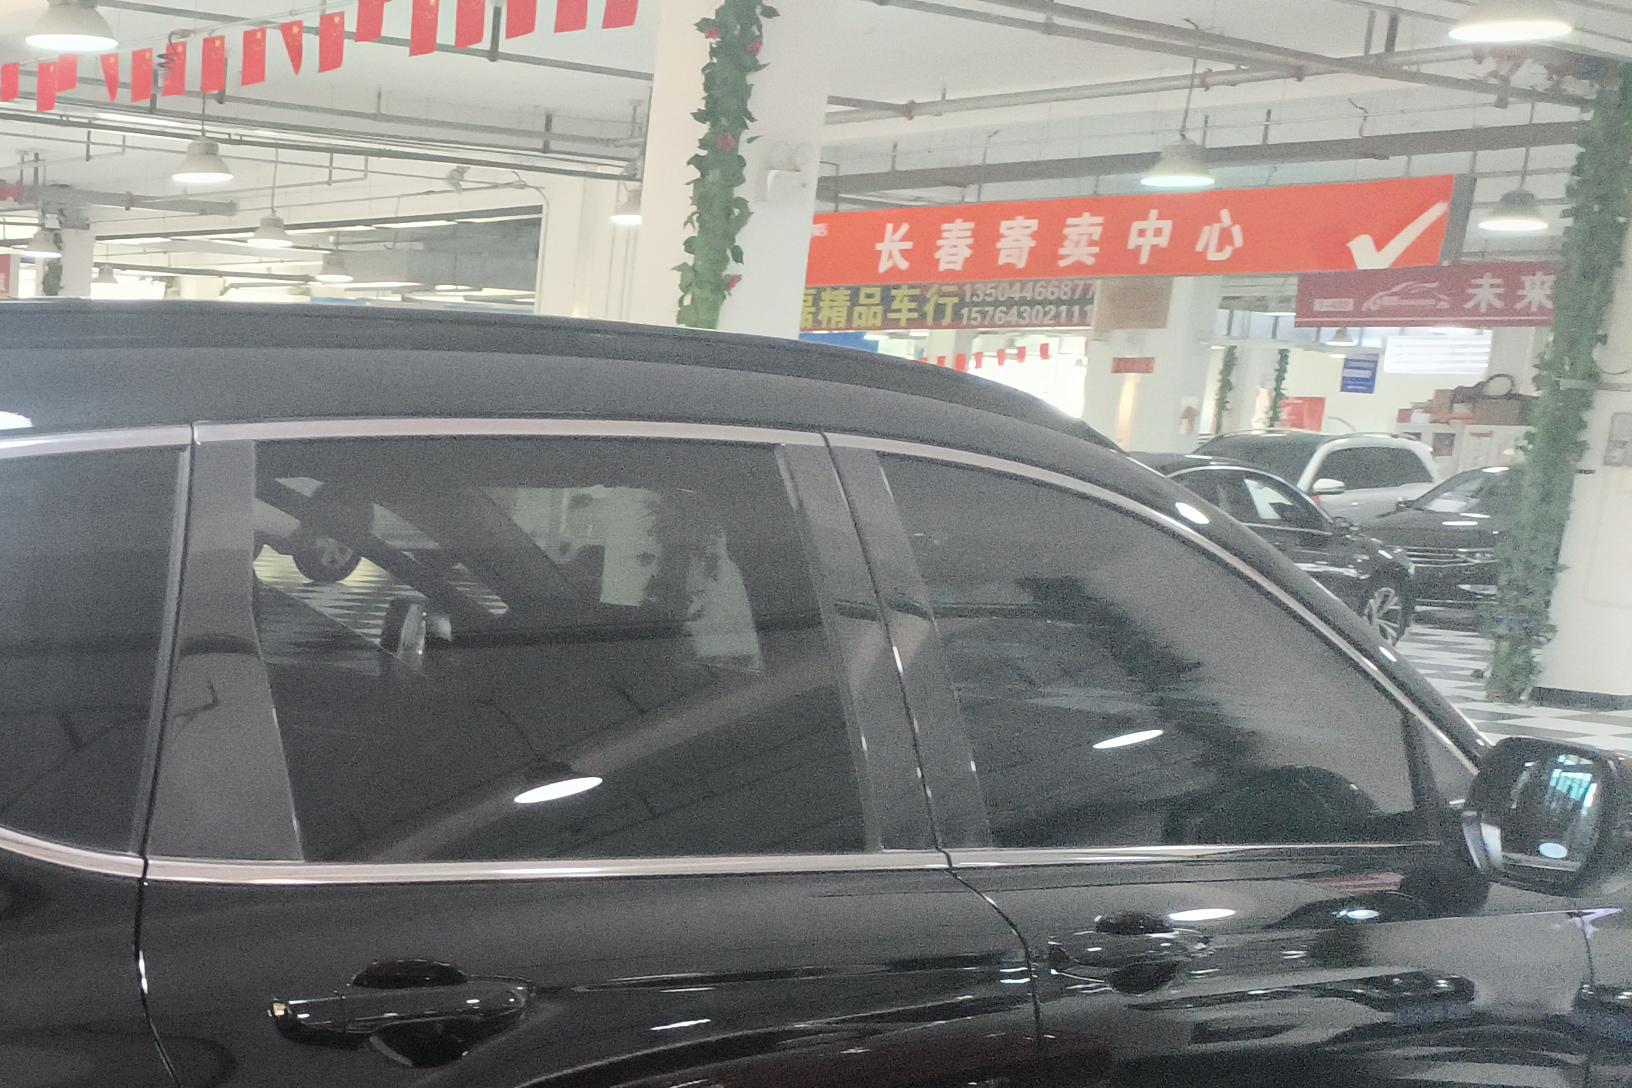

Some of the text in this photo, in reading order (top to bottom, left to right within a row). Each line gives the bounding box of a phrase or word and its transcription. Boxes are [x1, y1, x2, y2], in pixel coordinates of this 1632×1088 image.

[874, 209, 1244, 274] 长春寄卖中心
[1464, 271, 1555, 312] 未来
